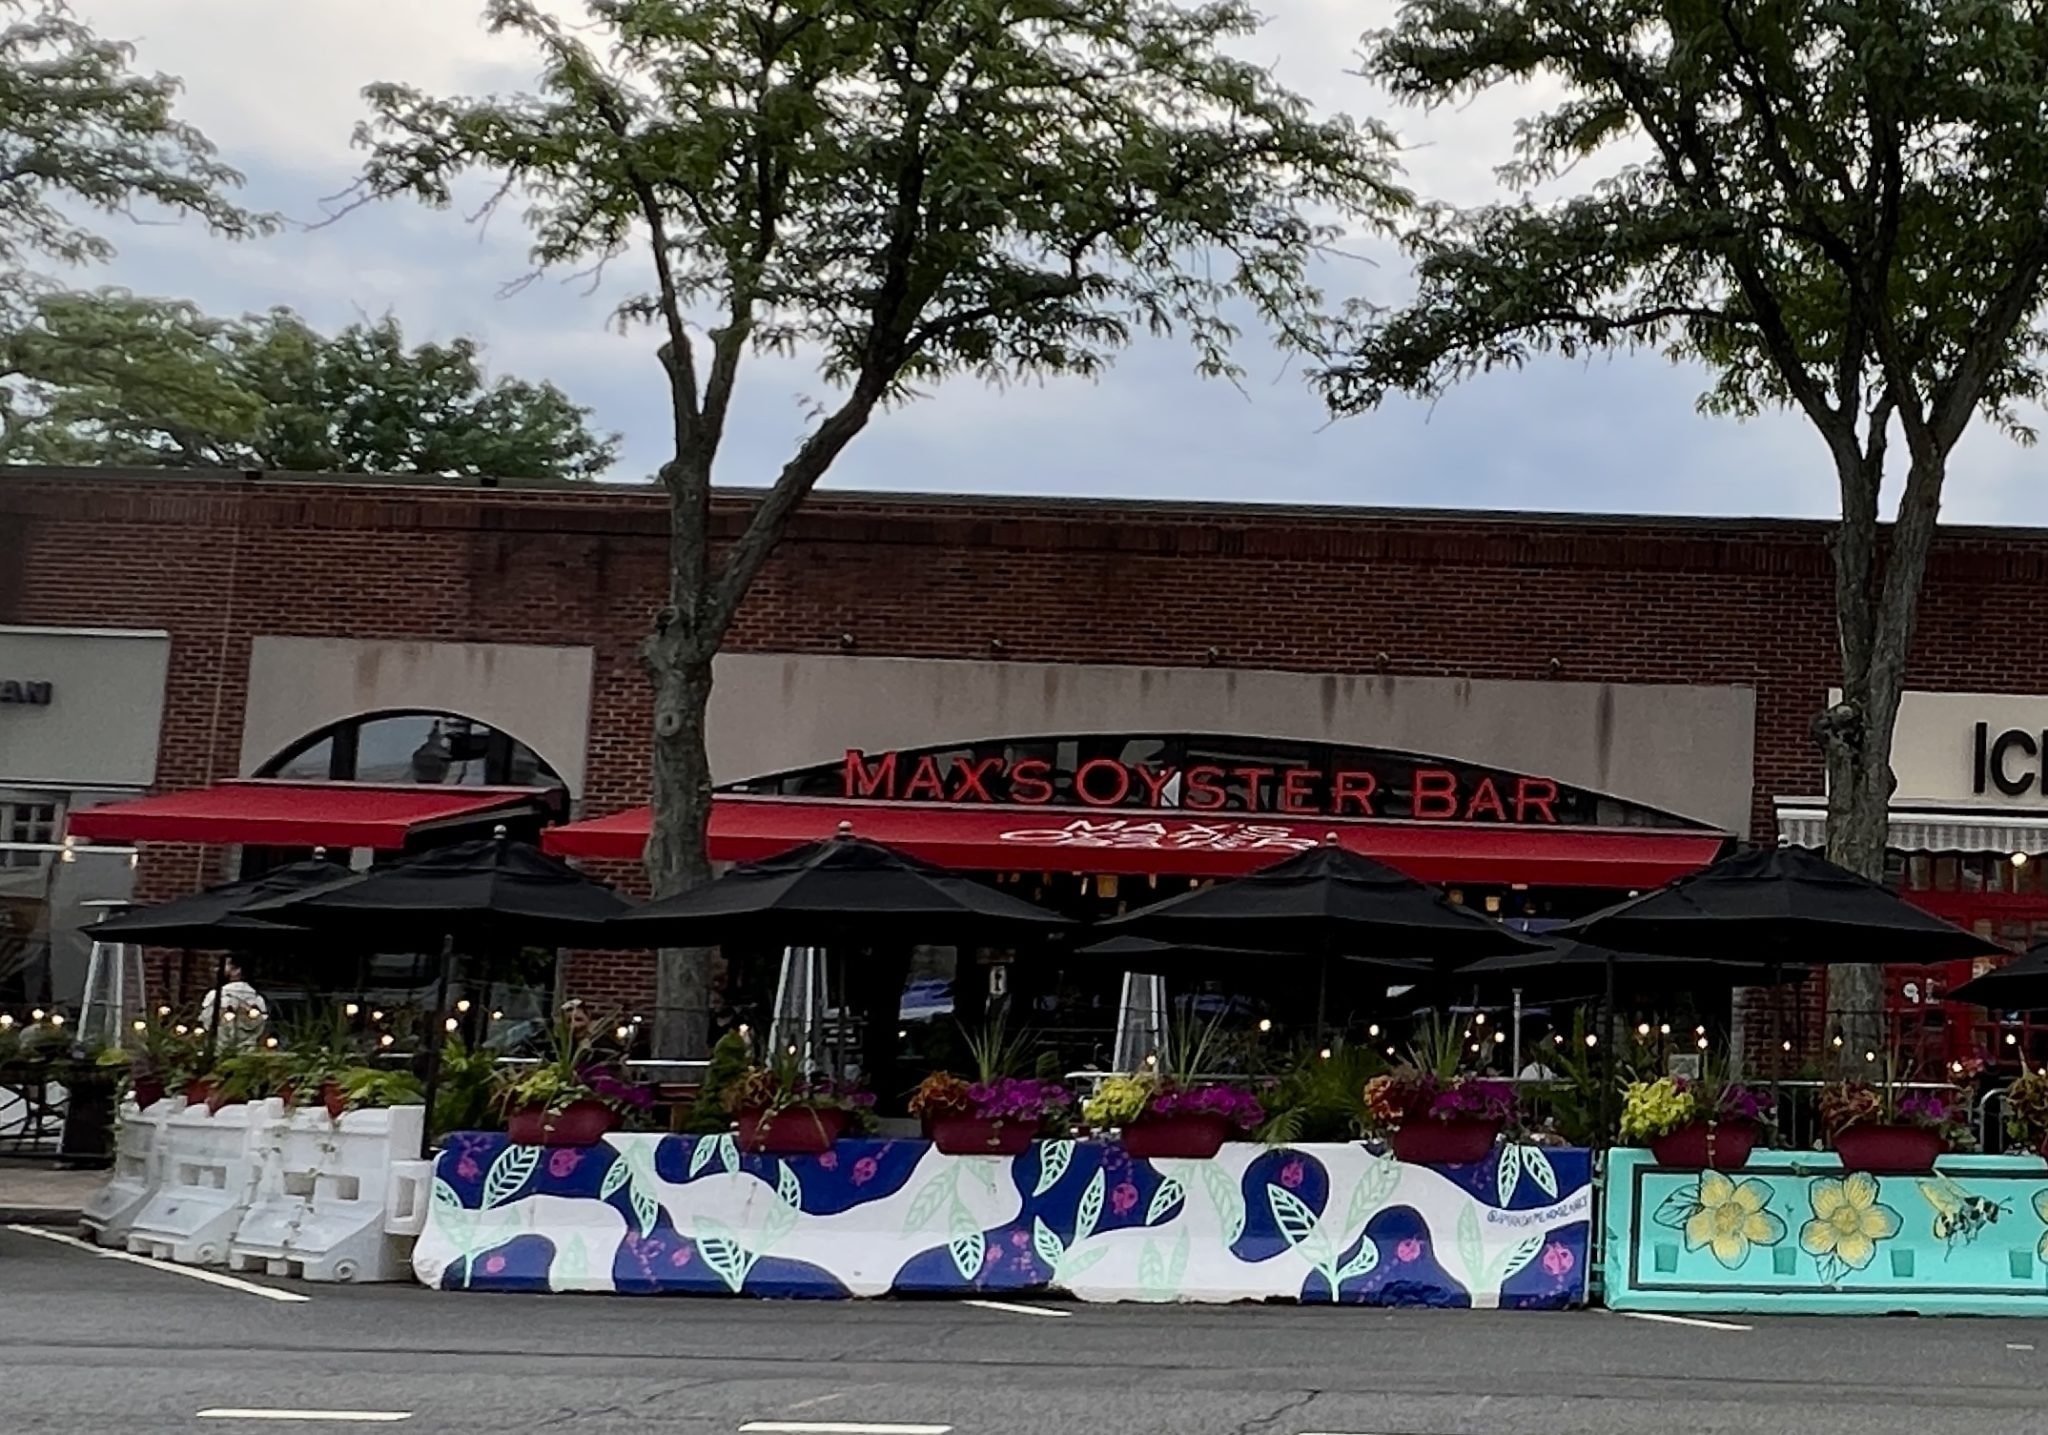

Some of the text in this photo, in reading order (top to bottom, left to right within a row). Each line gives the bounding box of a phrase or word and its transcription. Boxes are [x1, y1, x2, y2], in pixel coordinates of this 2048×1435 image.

[844, 749, 1558, 824] MAX'S OYSTER BAR
[1973, 721, 2048, 796] IC
